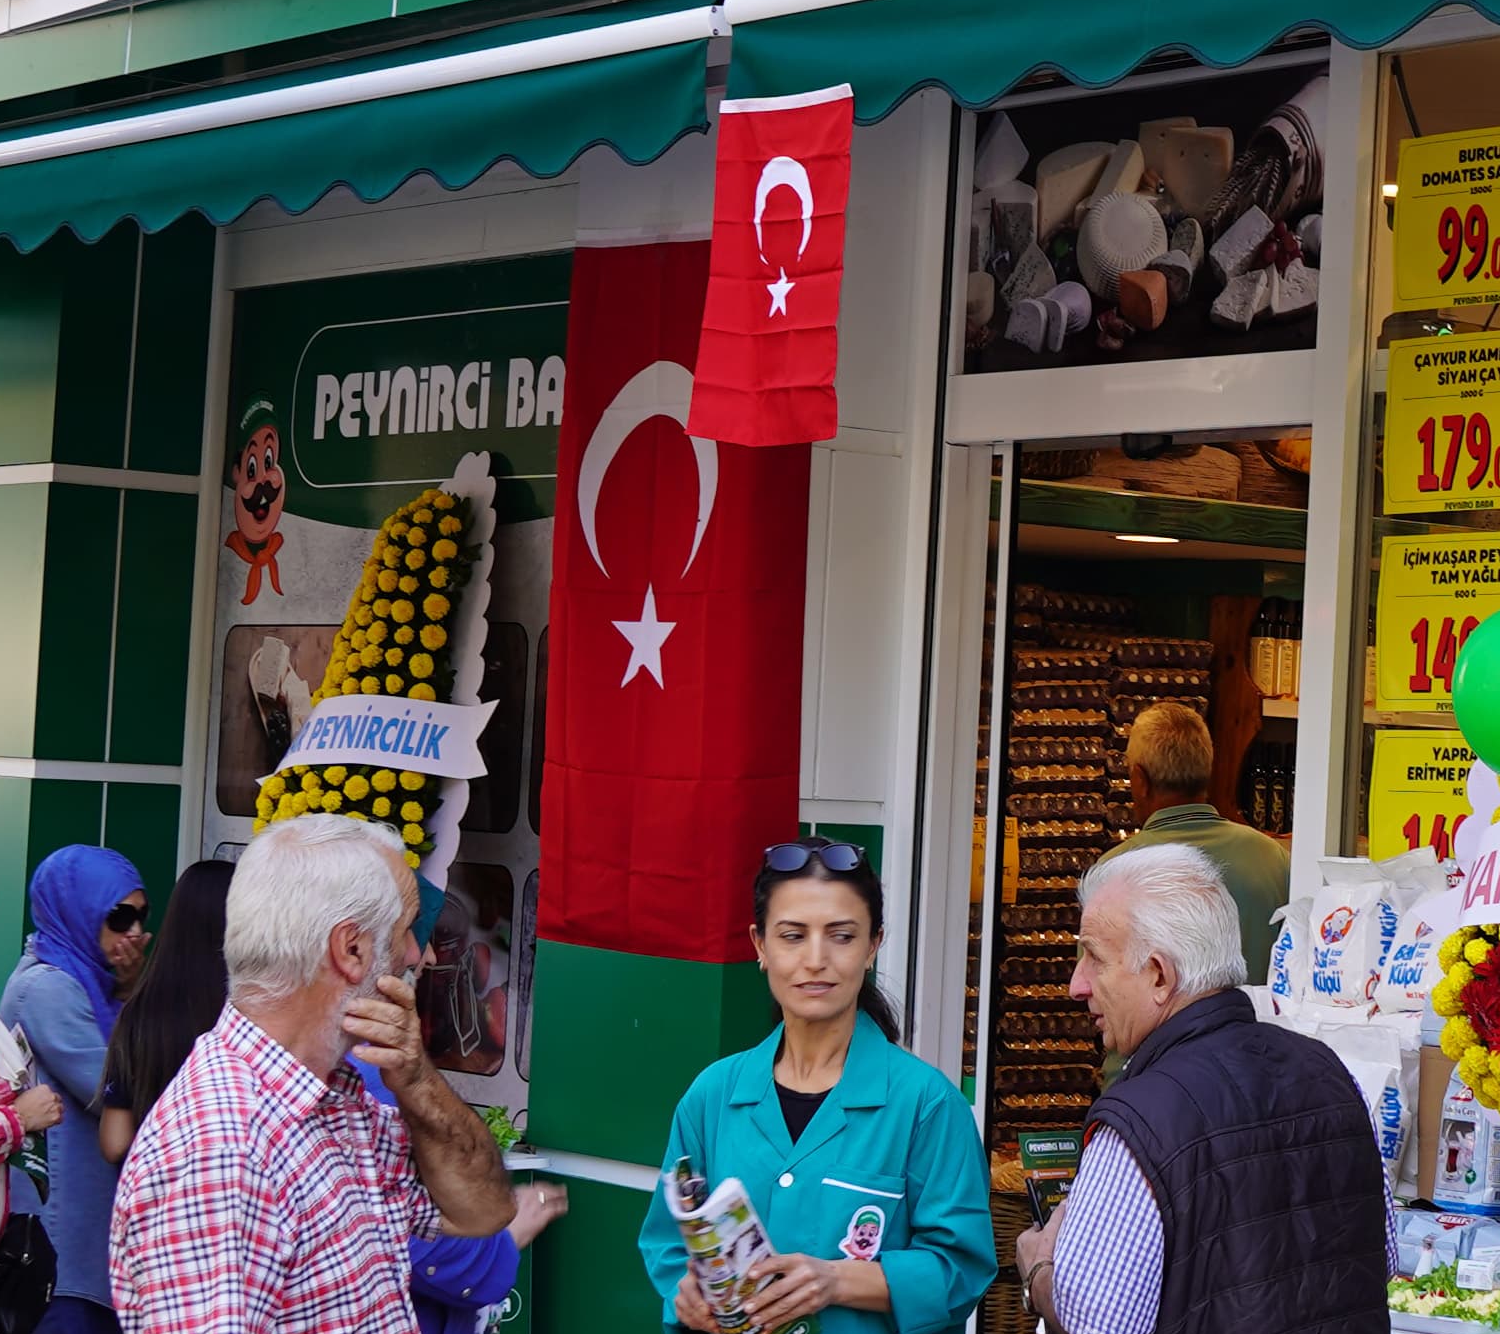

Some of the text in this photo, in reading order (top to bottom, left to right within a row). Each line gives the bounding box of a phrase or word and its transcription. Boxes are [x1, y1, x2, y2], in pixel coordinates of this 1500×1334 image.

[1421, 166, 1486, 188] DOMATES
[1414, 347, 1468, 372] ÇAYKUR
[1437, 363, 1478, 387] SİYAH
[1403, 546, 1431, 569] İÇİM
[1432, 547, 1477, 571] KAŞAR
[1430, 569, 1461, 586] TAM
[308, 704, 449, 761] PEYNİRCİLİK
[1407, 761, 1457, 781] ERİTME
[1393, 942, 1418, 962] Bal
[1388, 963, 1424, 989] Küpü
